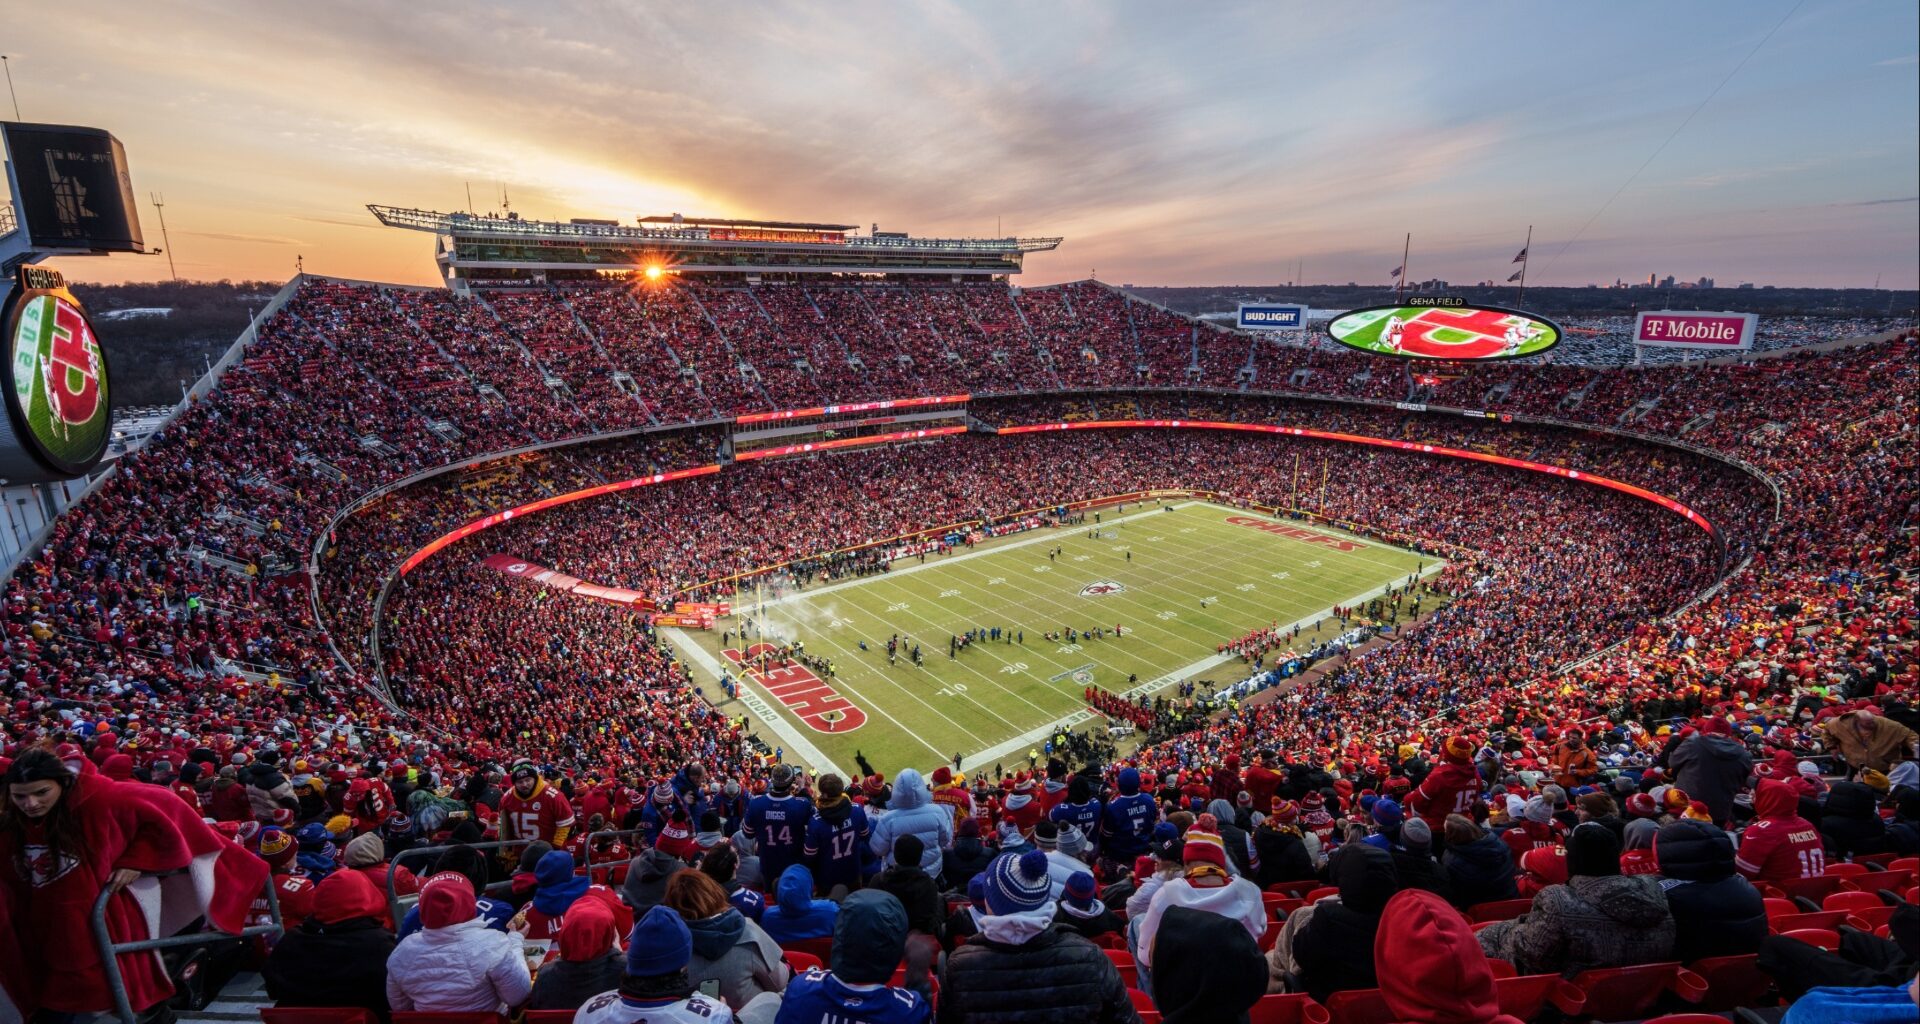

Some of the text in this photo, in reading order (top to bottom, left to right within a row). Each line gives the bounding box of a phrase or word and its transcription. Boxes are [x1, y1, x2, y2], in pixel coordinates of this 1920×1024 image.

[739, 230, 820, 241] SUPER BOWL CHAMPIONS
[1410, 297, 1463, 306] GEHA FIELD
[1245, 312, 1296, 321] BUD LIGHT
[1647, 320, 1735, 340] T Mobile
[1225, 516, 1370, 553] CHIEFS
[999, 662, 1029, 675] 20
[935, 683, 968, 697] 10
[765, 810, 786, 820] DIGGS
[1077, 811, 1094, 820] ALLEN
[1127, 805, 1147, 816] TAYLOR
[510, 811, 540, 841] 15
[765, 825, 793, 846] 14
[831, 830, 855, 860] 17
[1797, 847, 1825, 879] 10
